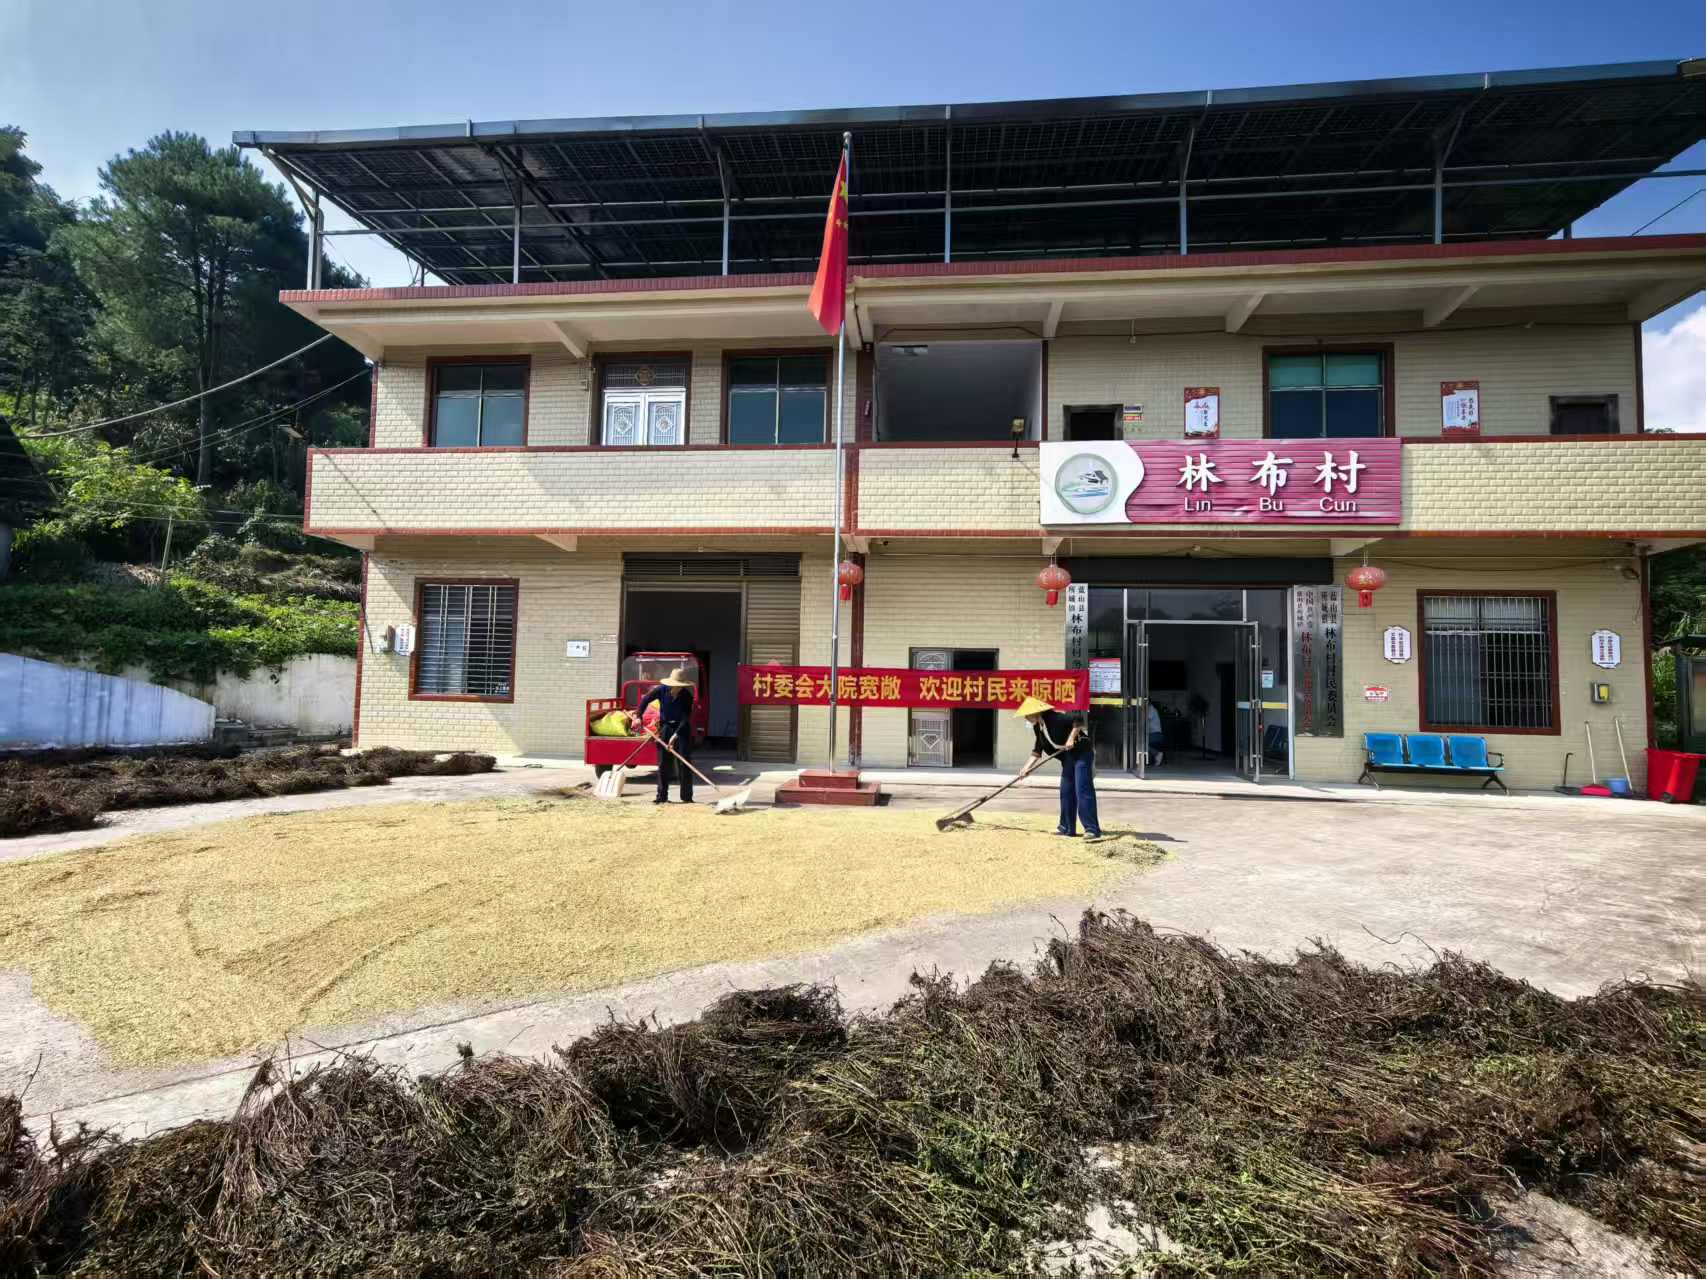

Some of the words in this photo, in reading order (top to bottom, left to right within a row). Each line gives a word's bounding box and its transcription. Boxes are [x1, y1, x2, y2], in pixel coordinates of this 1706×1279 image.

[1176, 450, 1367, 496] 林布村
[1184, 497, 1212, 512] Lin
[1259, 497, 1284, 512] Bu
[1319, 497, 1357, 512] Cun
[752, 672, 902, 701] 村委会大院宽敞
[919, 676, 1077, 704] 欢迎村民来晾晒
